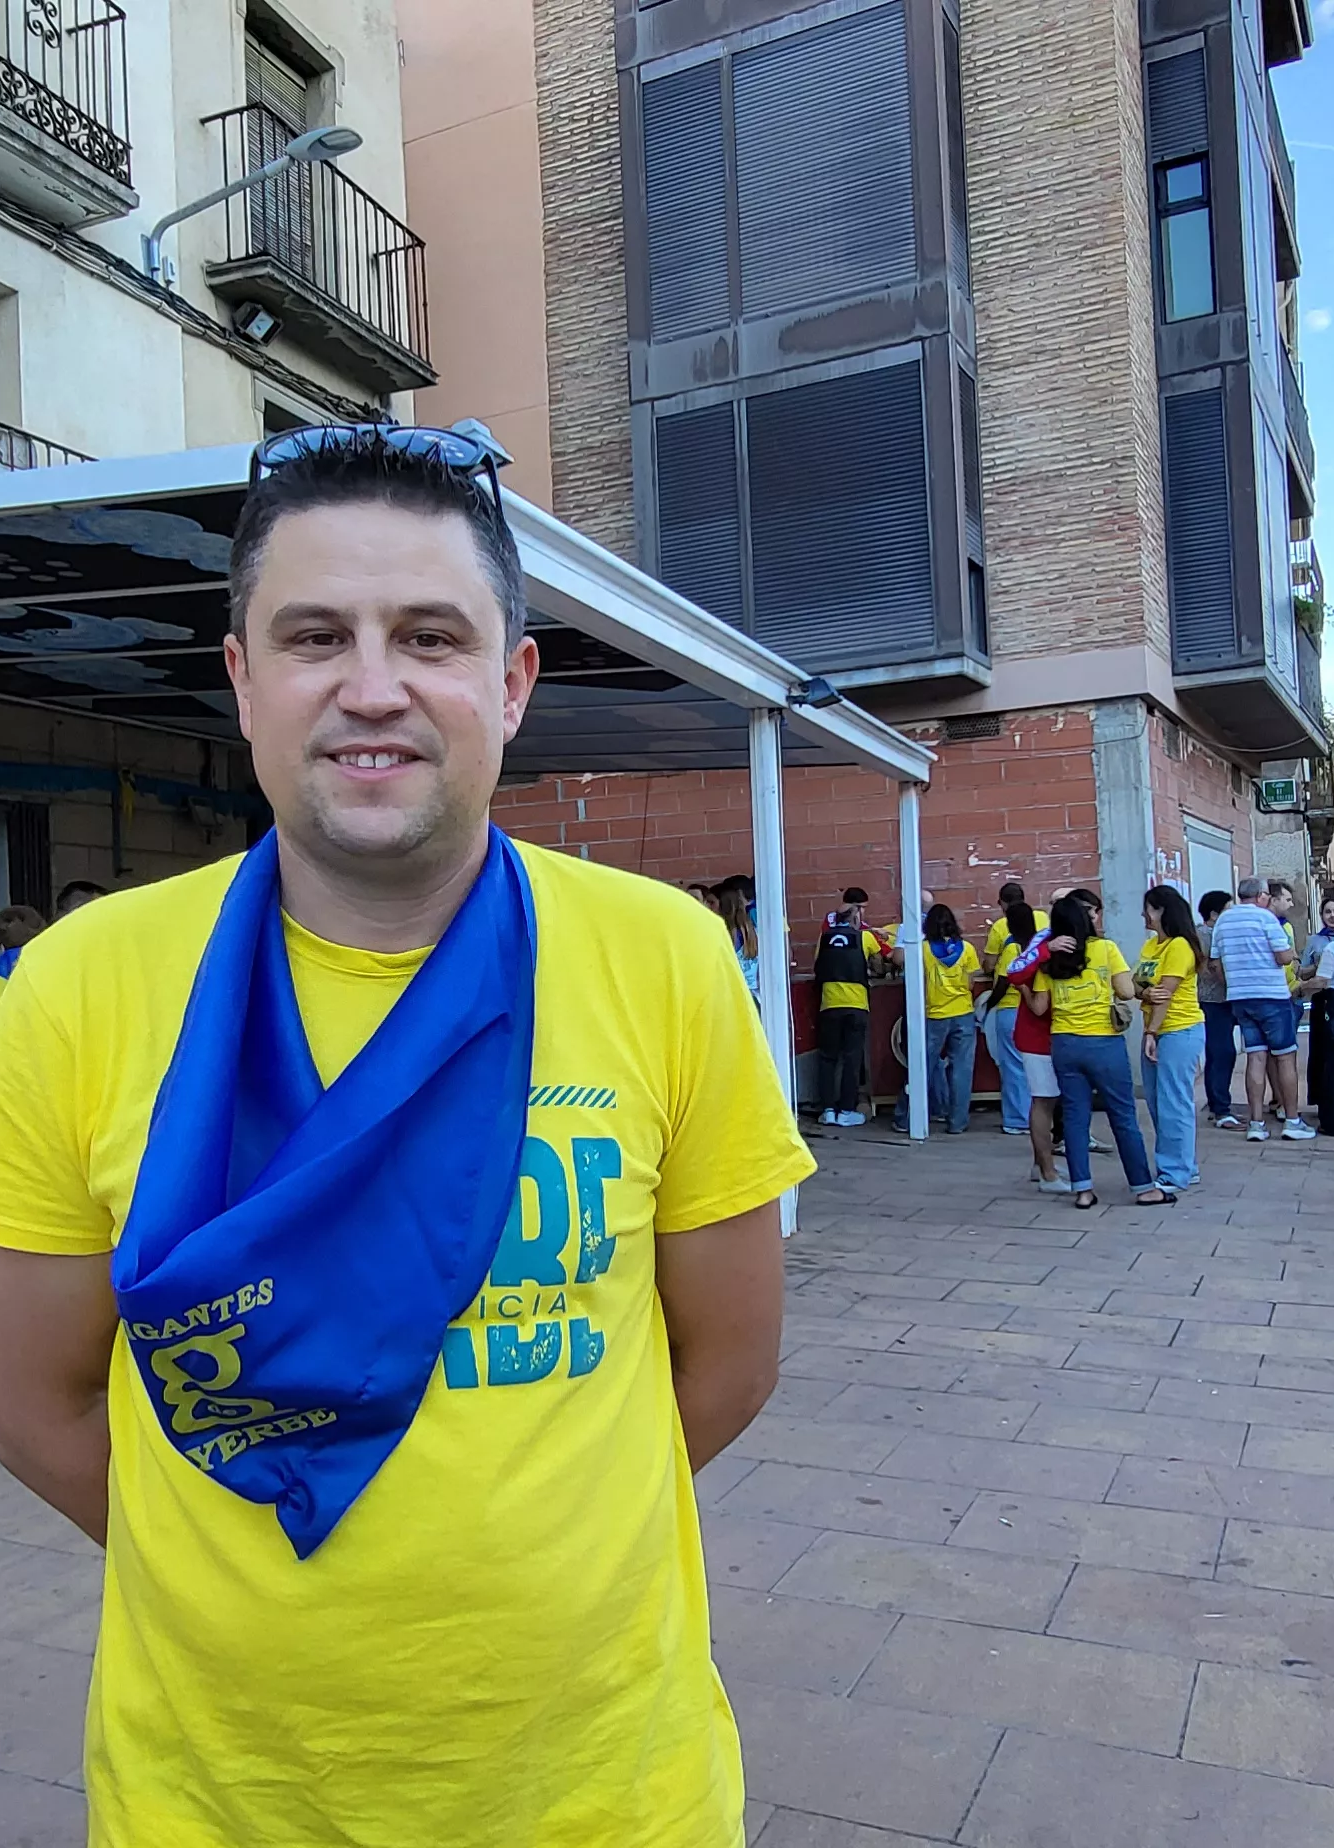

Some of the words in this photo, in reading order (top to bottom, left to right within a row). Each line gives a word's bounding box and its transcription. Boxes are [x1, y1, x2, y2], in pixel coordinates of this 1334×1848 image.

[121, 1278, 274, 1341] IGANTES
[478, 1291, 567, 1320] ICIA
[184, 1407, 337, 1470] YERBE
